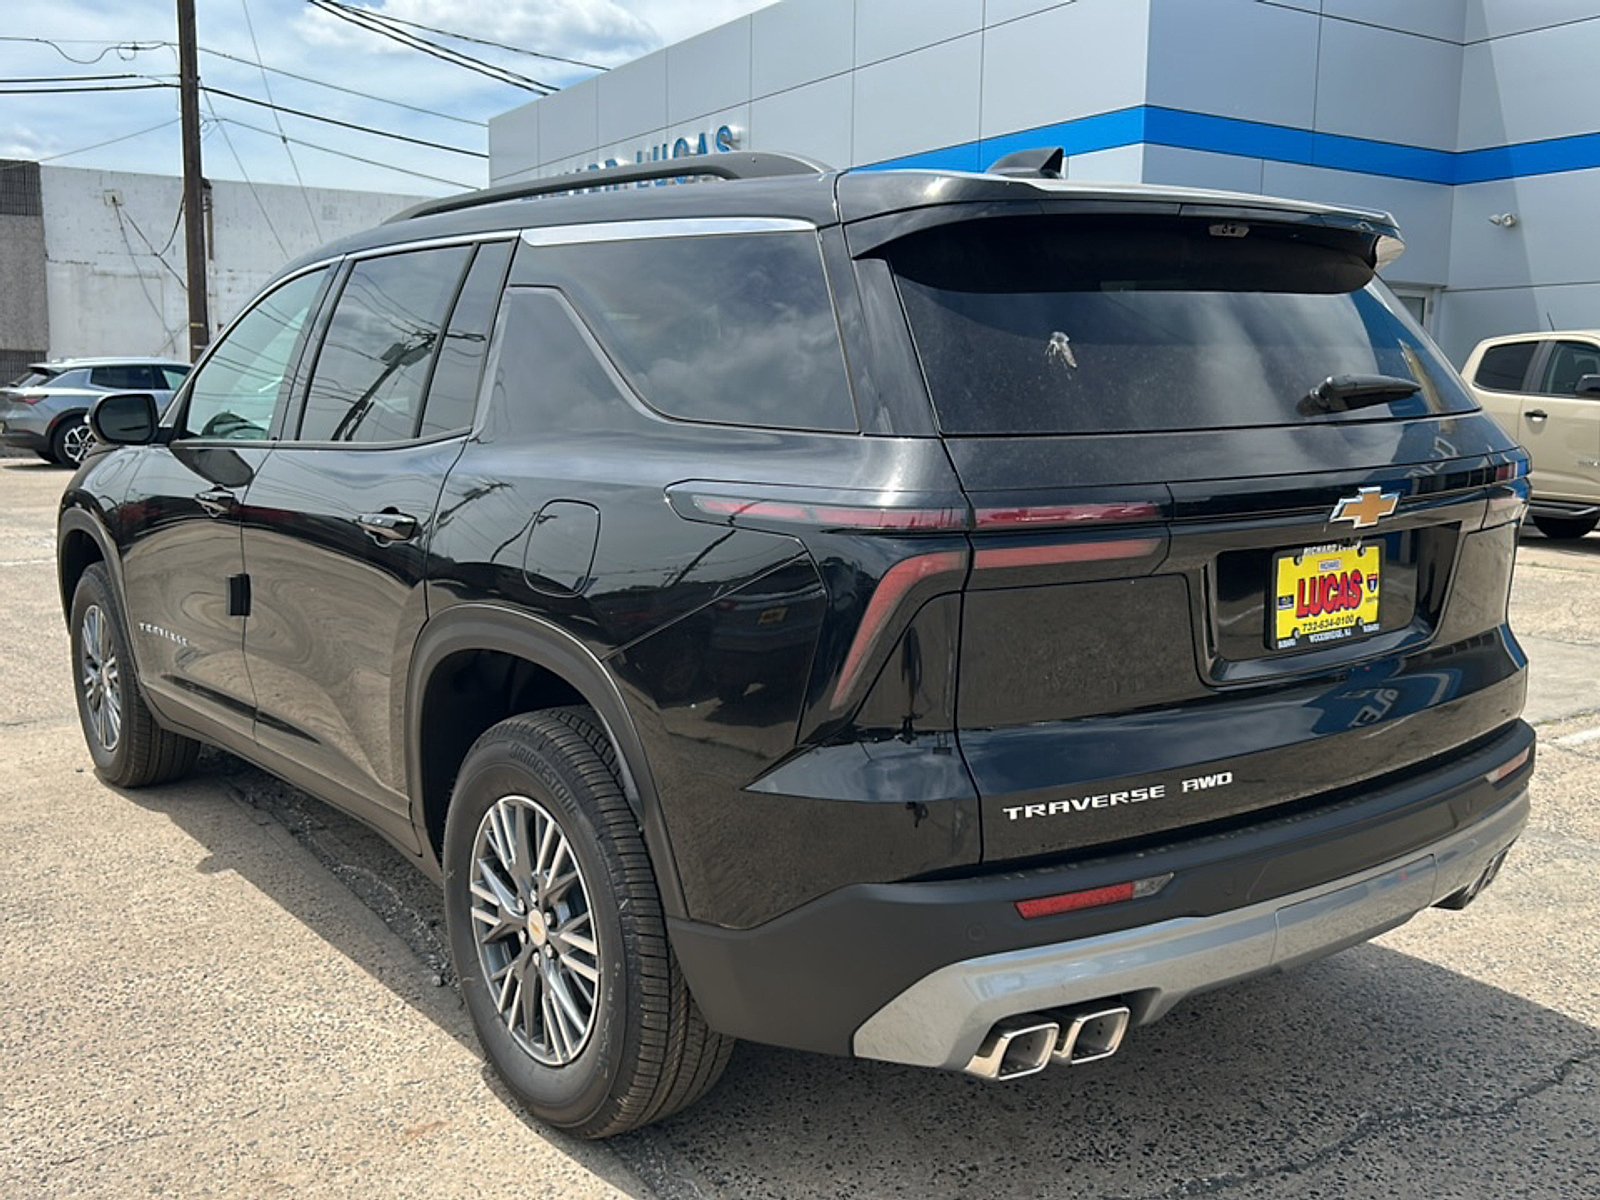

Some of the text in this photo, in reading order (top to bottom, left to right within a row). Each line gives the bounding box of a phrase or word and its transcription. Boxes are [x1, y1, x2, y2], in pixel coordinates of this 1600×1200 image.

[1296, 569, 1363, 618] LUCAS
[1303, 615, 1355, 632] 732-634-0100
[509, 742, 579, 817] BRIDGESTONE
[1002, 771, 1233, 821] TRAVERSE AWD
